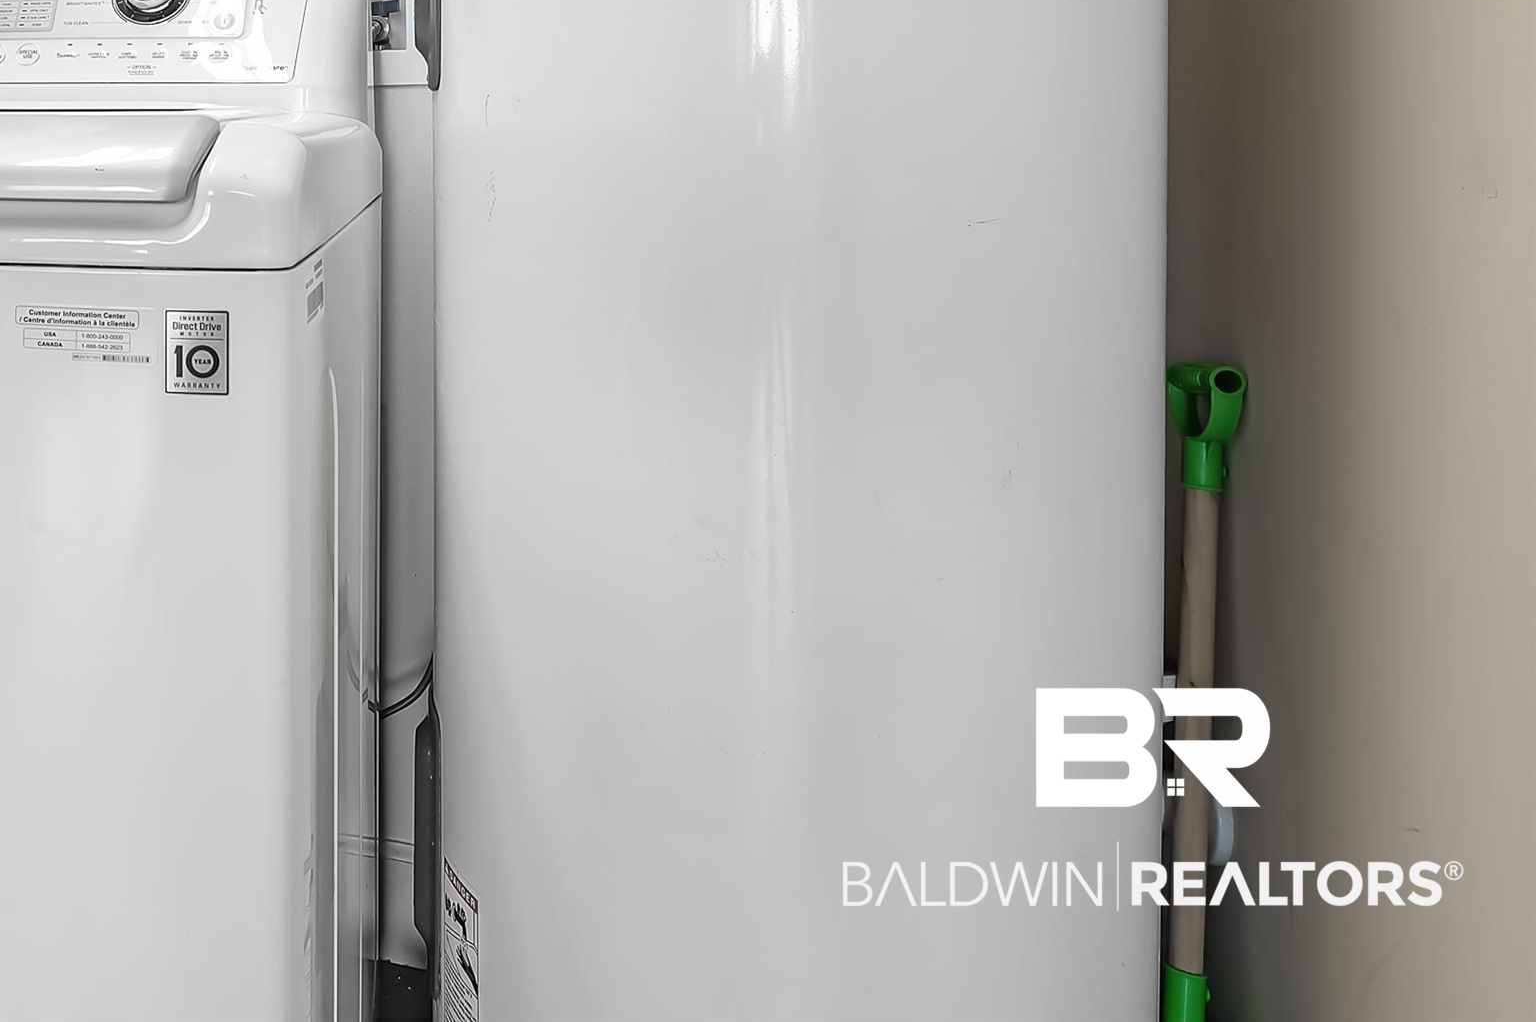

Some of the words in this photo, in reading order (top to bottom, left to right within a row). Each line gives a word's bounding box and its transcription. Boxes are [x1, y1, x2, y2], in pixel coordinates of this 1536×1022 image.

[28, 308, 61, 317] Customer
[62, 310, 102, 319] Information
[103, 312, 126, 320] Center
[23, 316, 46, 324] Centre
[46, 317, 92, 326] d'information
[172, 321, 198, 331] Direct
[199, 322, 222, 332] Drive
[174, 344, 220, 379] 10
